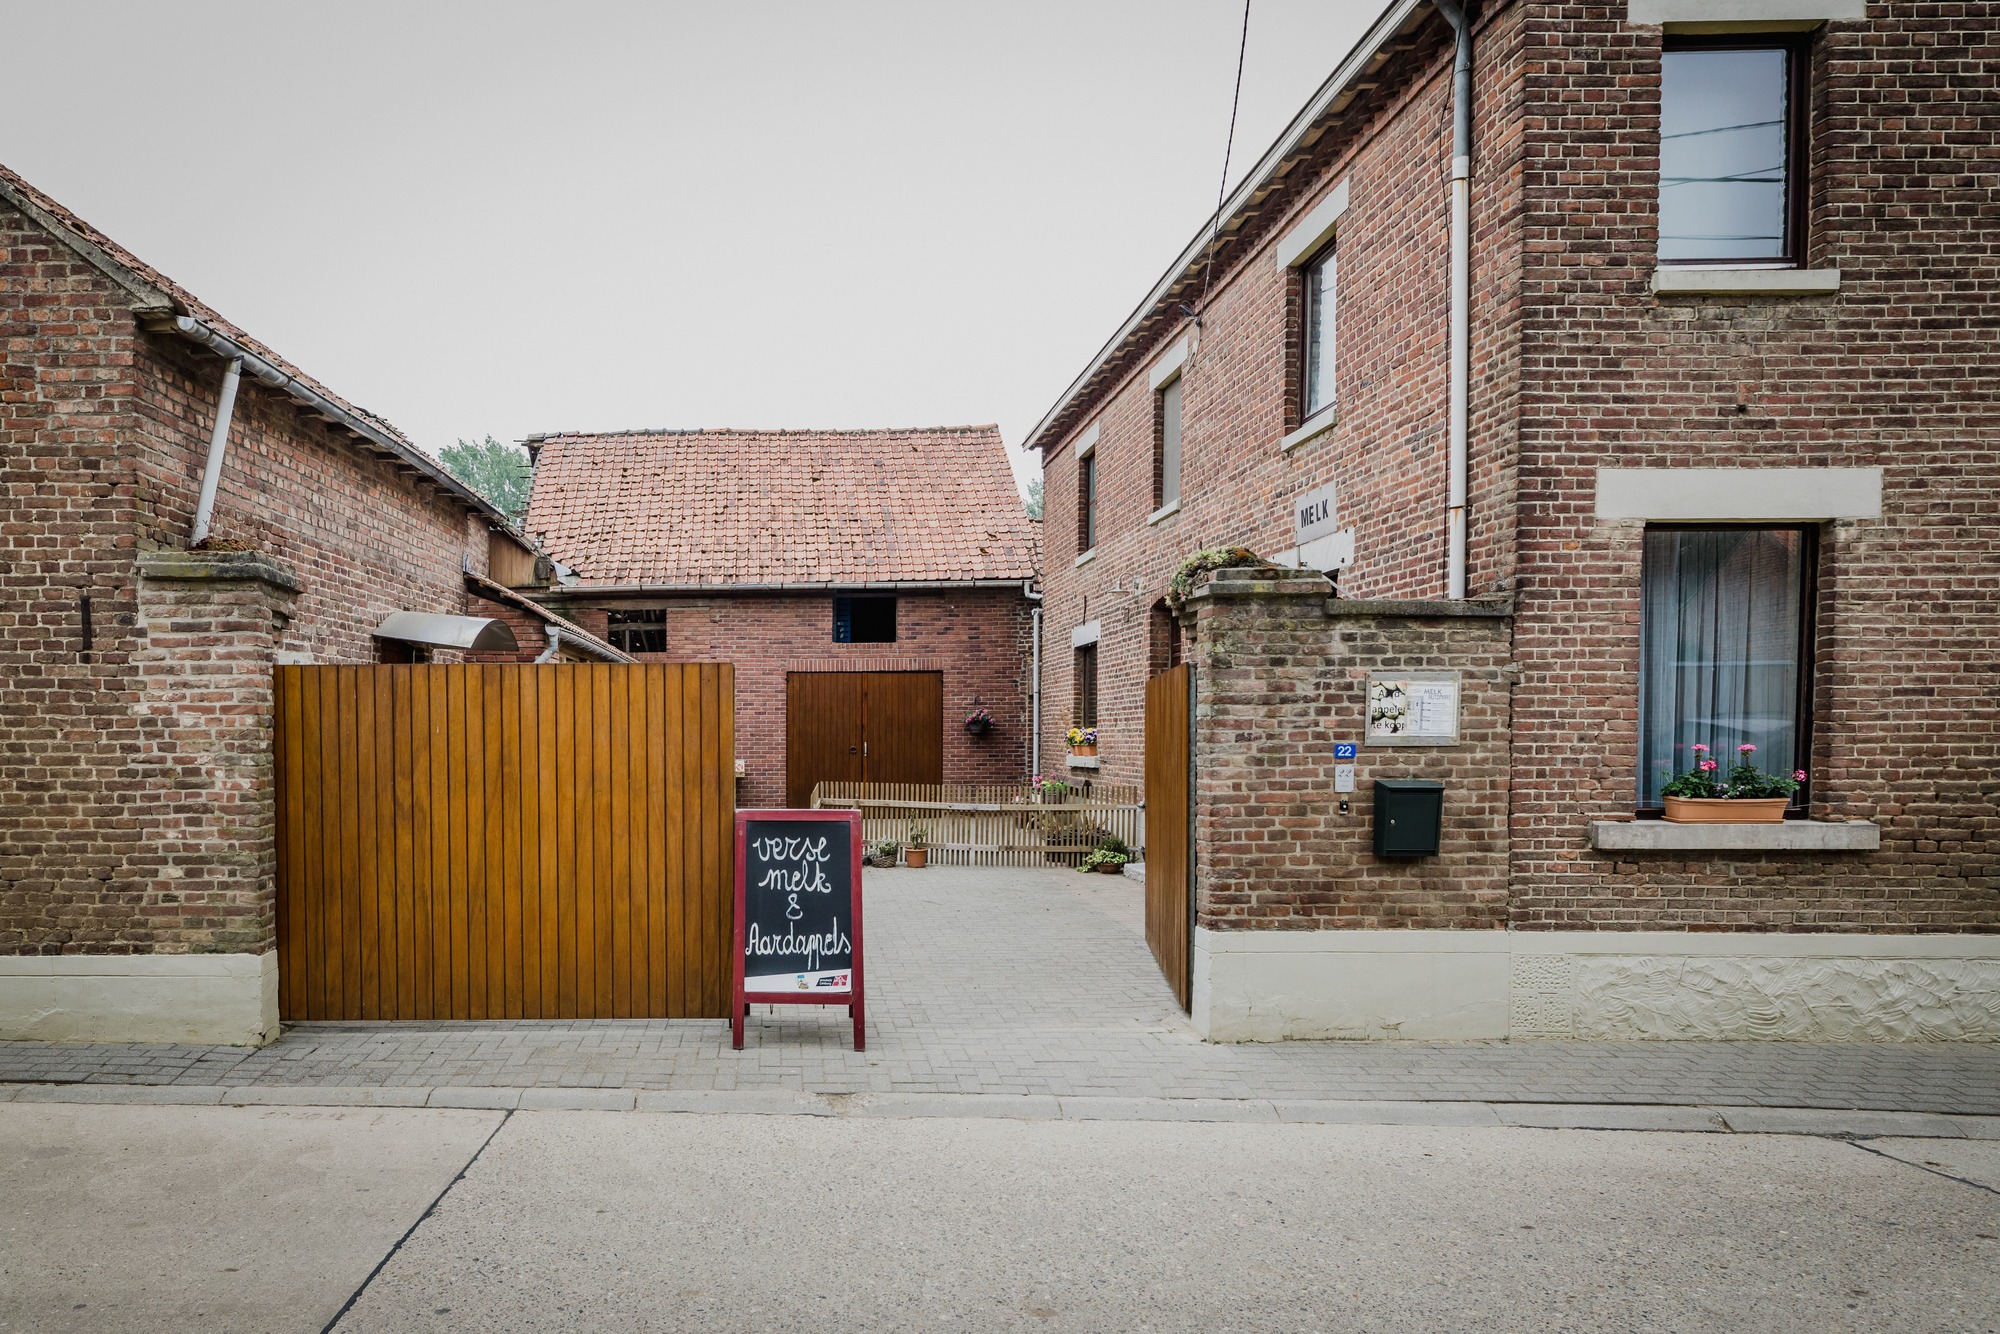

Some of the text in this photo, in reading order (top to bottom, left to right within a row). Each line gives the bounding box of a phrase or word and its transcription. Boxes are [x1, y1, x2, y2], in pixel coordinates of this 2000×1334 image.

[1301, 499, 1329, 528] MELK
[1337, 745, 1352, 757] 22
[752, 836, 831, 862] verse
[758, 859, 832, 893] melk
[786, 893, 803, 920] &
[745, 916, 851, 971] Aardappels
